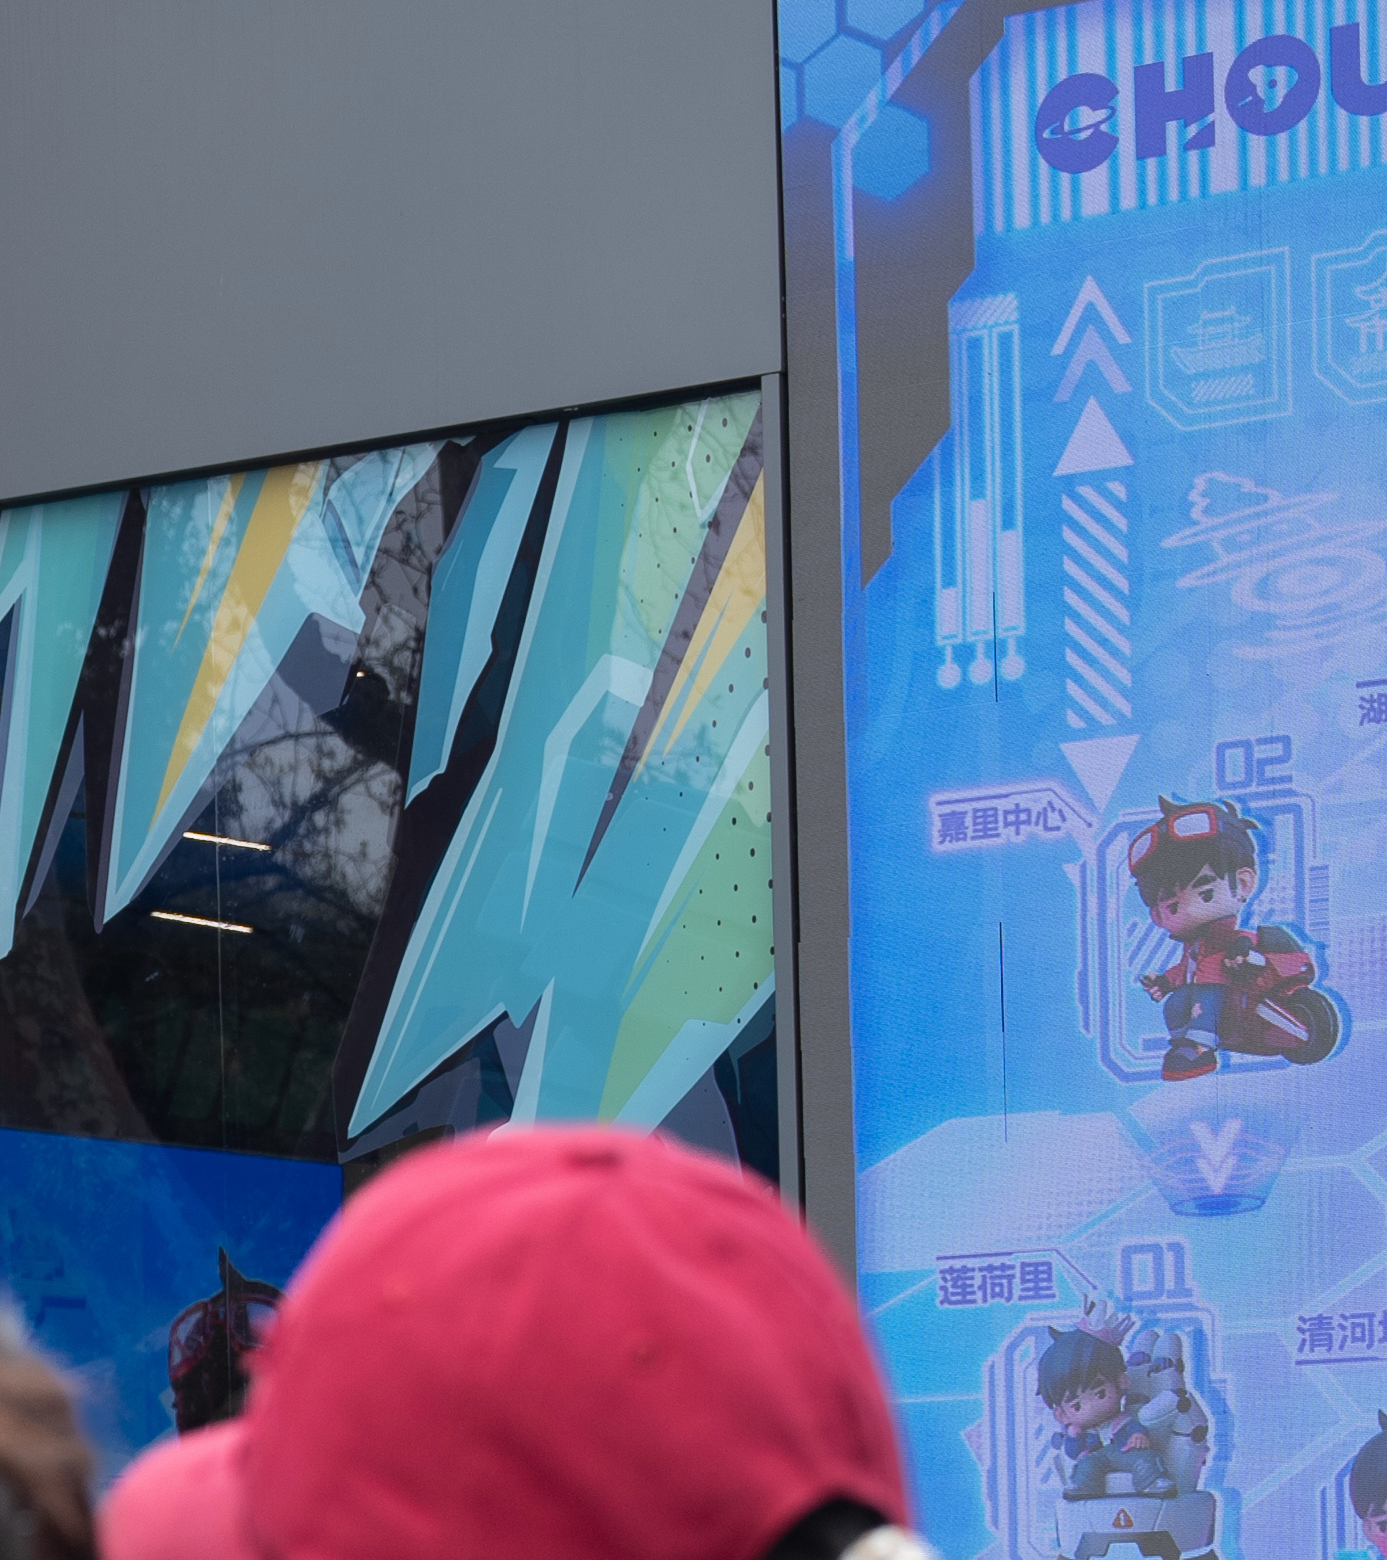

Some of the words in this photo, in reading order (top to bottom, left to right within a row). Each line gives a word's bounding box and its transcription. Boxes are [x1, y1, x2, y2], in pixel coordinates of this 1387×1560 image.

[1216, 735, 1292, 791] 02
[938, 800, 1066, 845] 嘉里中心
[938, 1260, 1057, 1306] 莲荷里
[1121, 1242, 1193, 1301] 01
